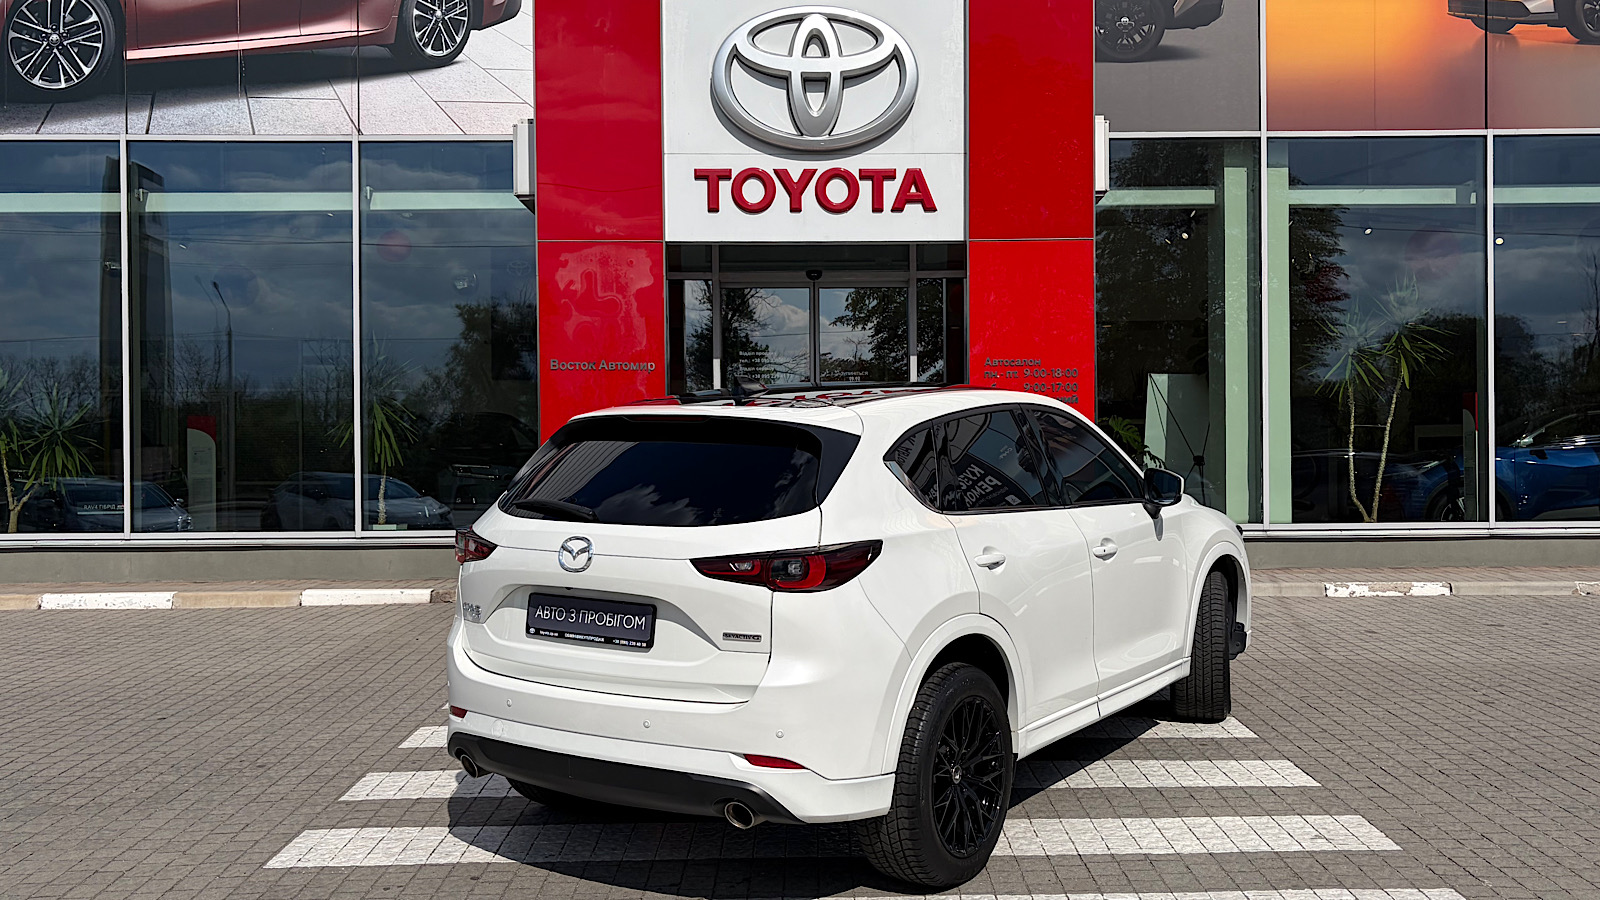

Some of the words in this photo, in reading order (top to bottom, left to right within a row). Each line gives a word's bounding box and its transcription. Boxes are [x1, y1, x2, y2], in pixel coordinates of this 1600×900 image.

[694, 167, 938, 214] TOYOTA
[550, 359, 597, 371] Восток
[599, 359, 656, 374] Автомир
[984, 357, 1041, 367] Автосалон
[1023, 368, 1079, 379] 9:00-18:00
[1023, 382, 1079, 393] 9:00-17:00
[535, 605, 566, 621] АВТО
[579, 609, 646, 631] ПРОБІГОМ
